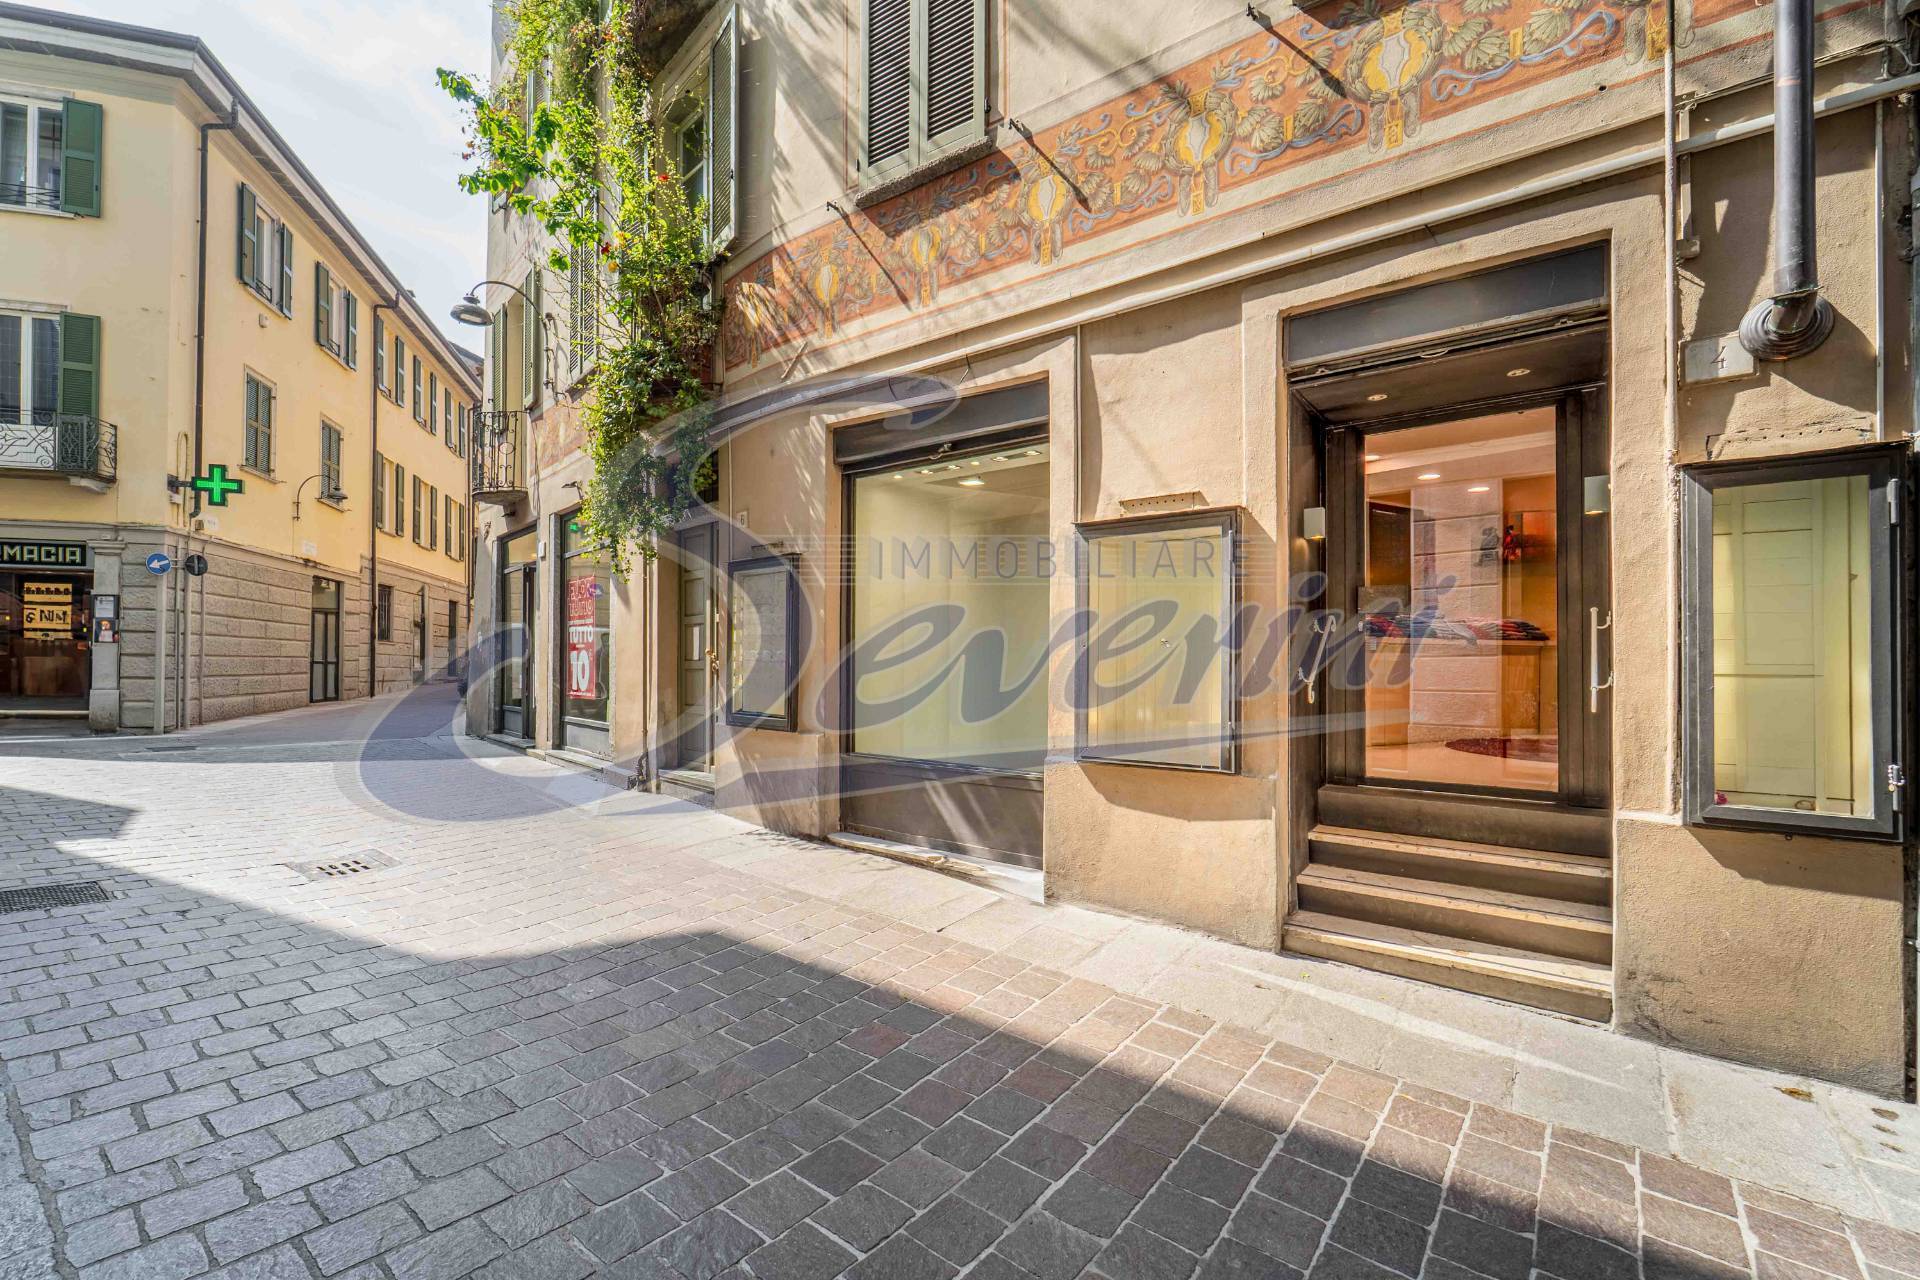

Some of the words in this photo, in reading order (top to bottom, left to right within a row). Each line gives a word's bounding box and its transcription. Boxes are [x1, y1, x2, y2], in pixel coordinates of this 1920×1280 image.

[1711, 346, 1726, 369] 4
[0, 544, 82, 563] MACIA
[569, 625, 593, 644] TUTTO
[570, 650, 589, 691] 10
